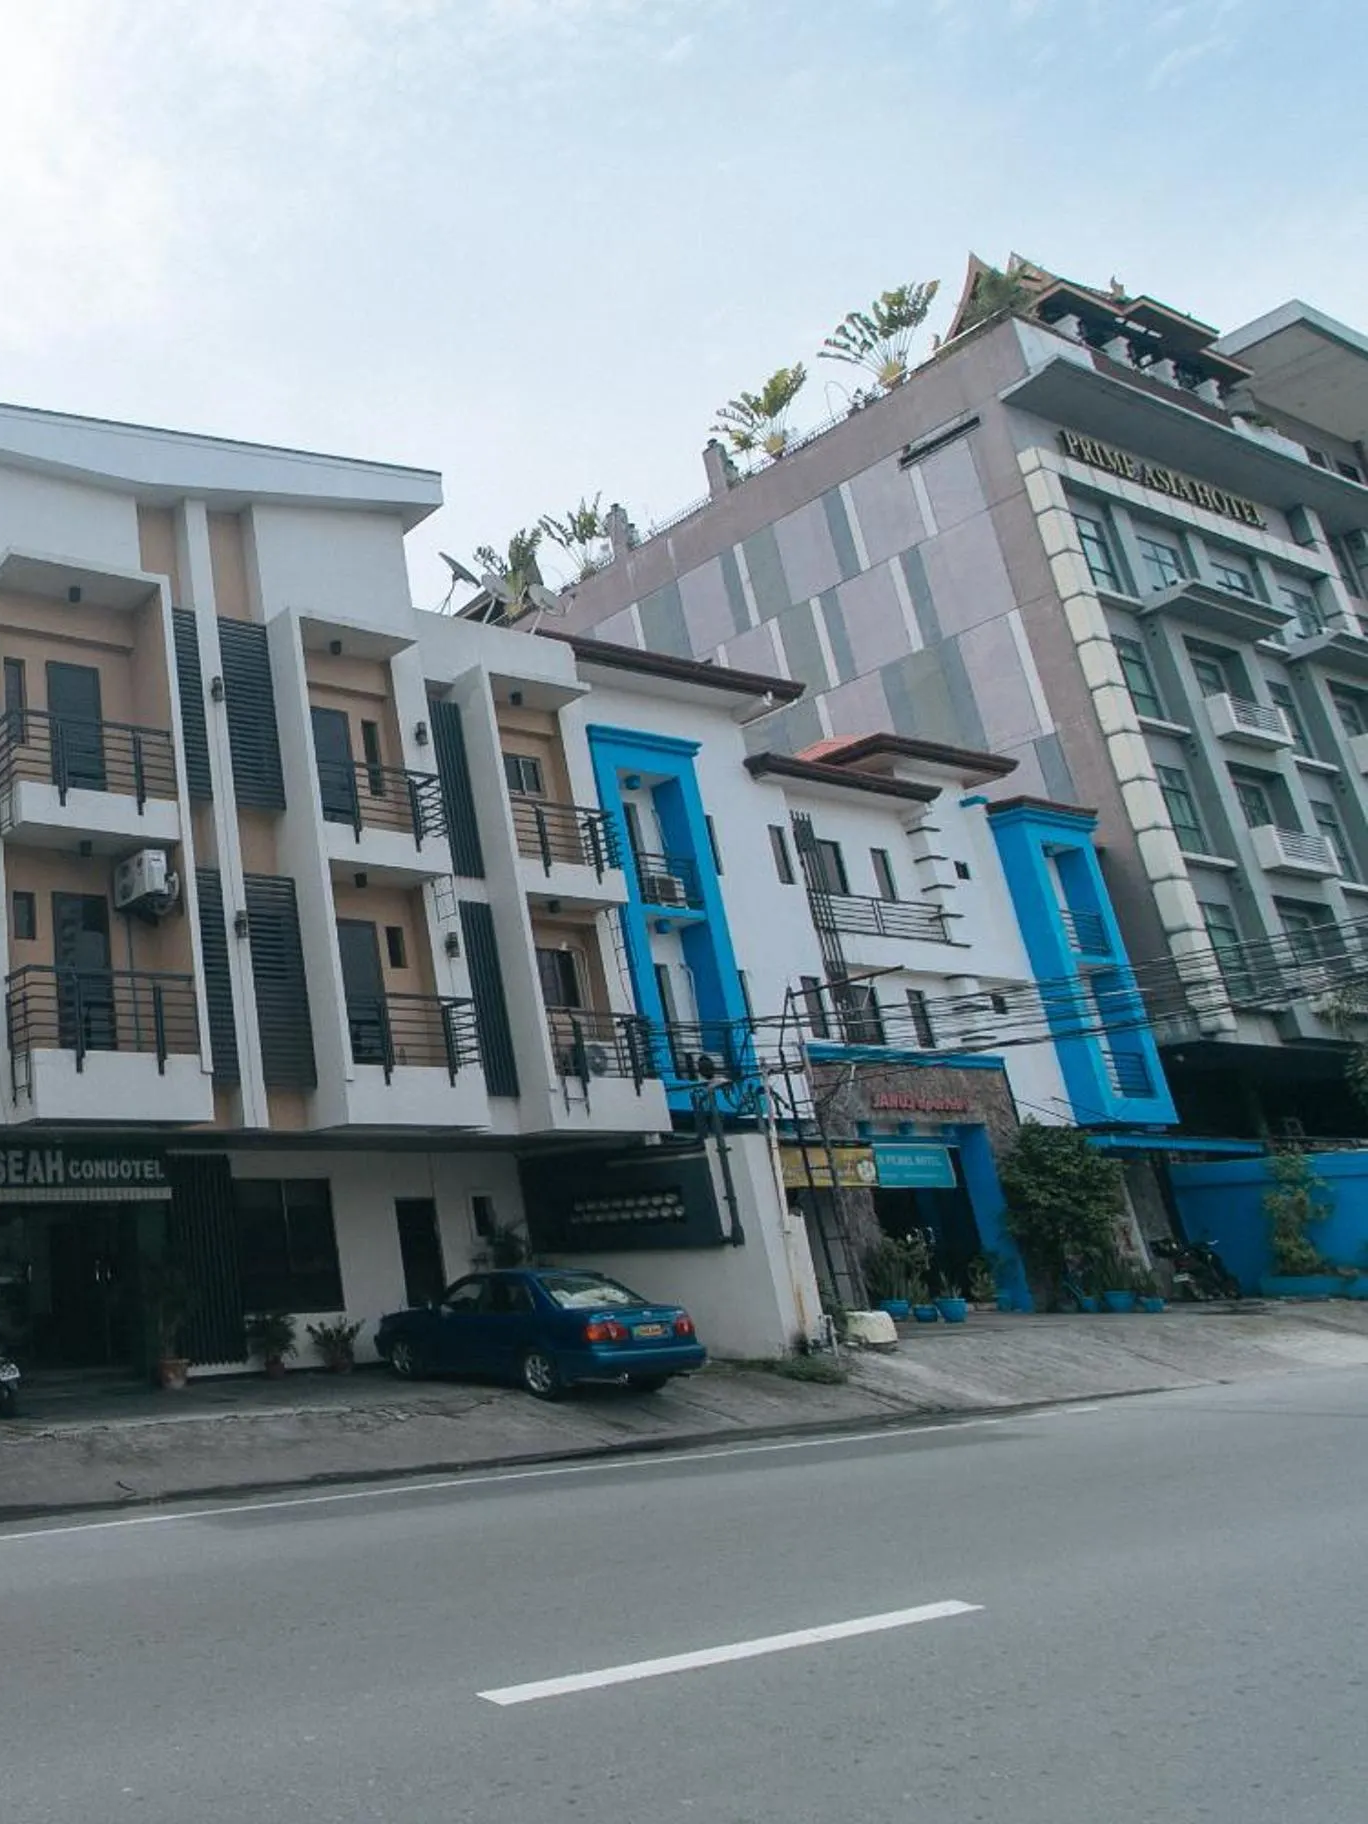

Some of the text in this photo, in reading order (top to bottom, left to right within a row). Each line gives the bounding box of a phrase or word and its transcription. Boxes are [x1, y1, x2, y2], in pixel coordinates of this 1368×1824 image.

[1061, 429, 1268, 530] PRIME ASIA HOTEL
[68, 1160, 166, 1180] CONDOTEL
